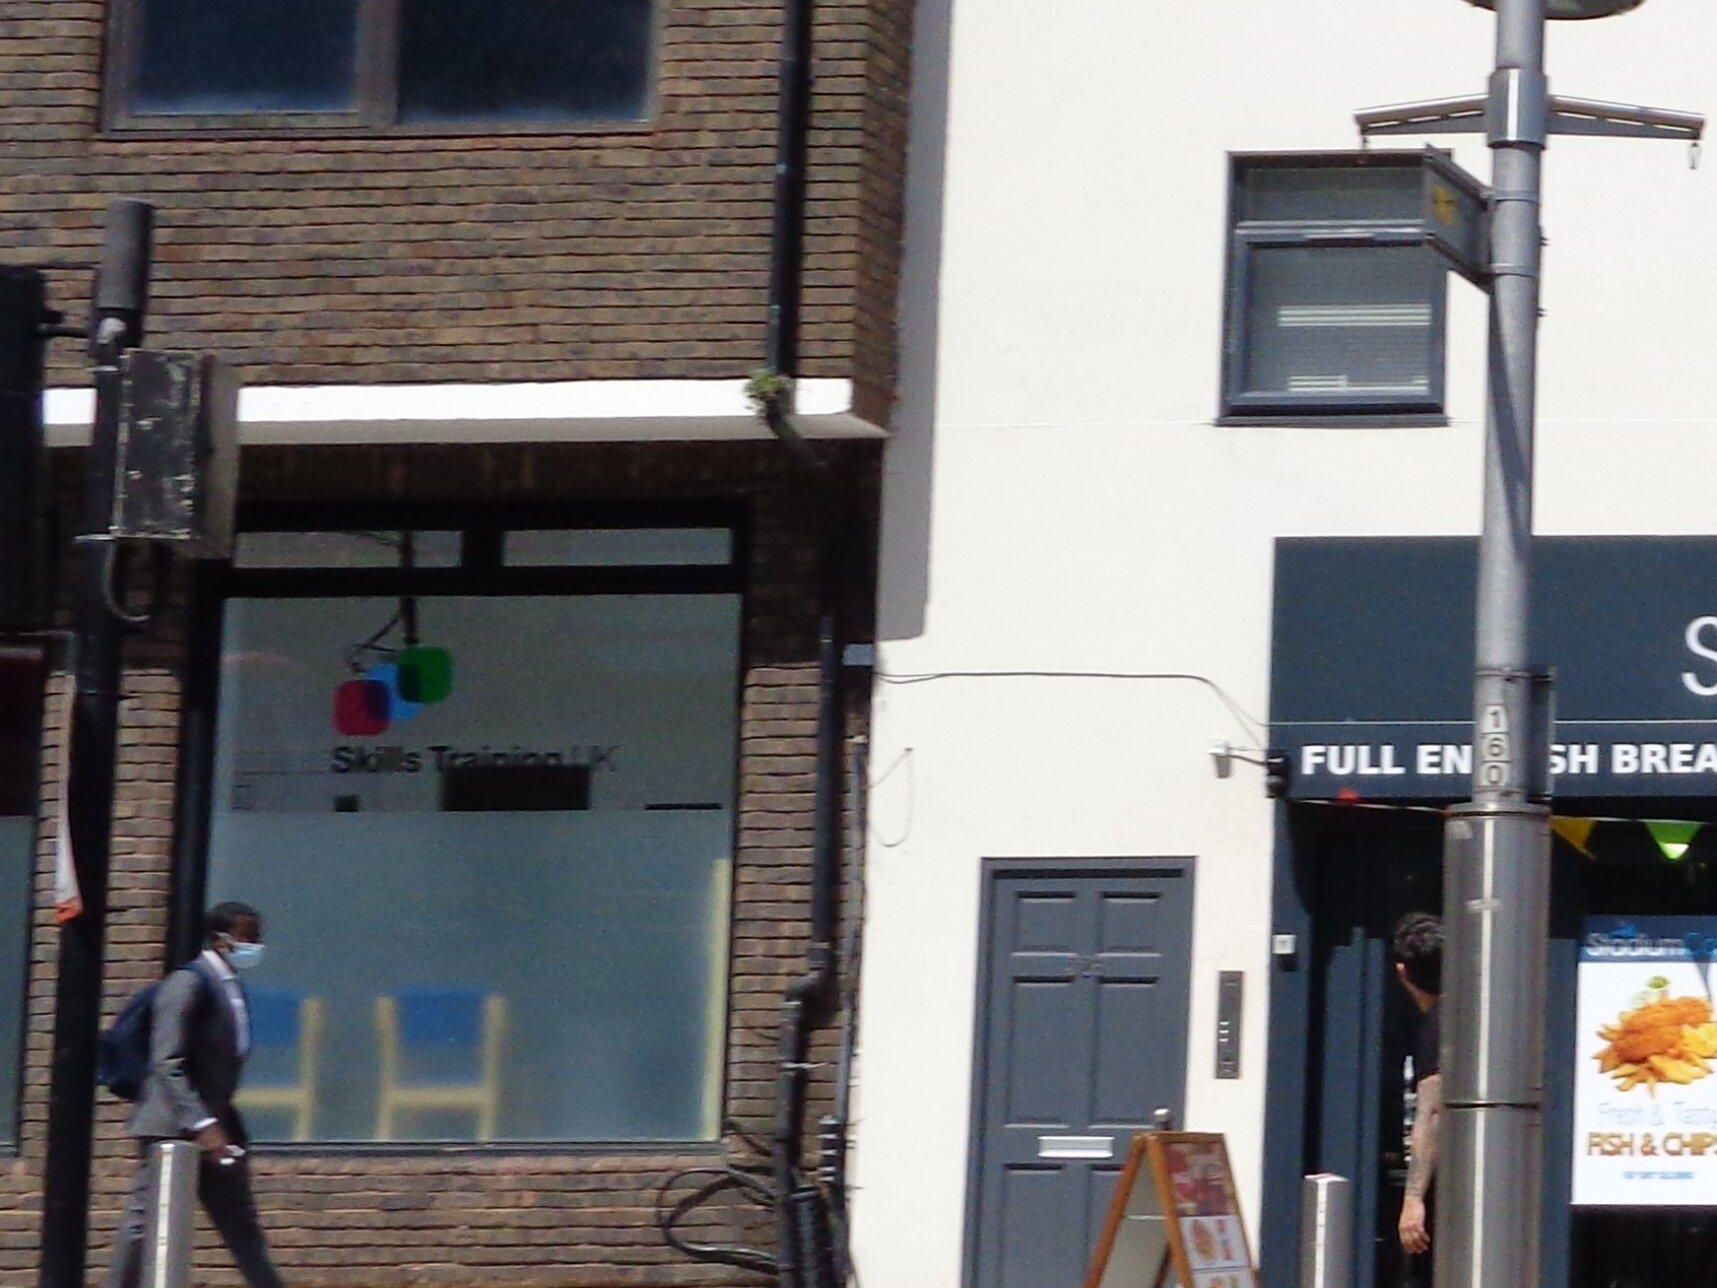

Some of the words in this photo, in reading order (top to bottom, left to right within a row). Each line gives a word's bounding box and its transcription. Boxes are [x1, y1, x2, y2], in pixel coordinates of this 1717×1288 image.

[332, 745, 421, 773] Skills
[1301, 743, 1405, 776] FULL
[1415, 743, 1599, 776] ENSH
[1587, 1132, 1634, 1156] FISH
[1640, 1132, 1659, 1156] &
